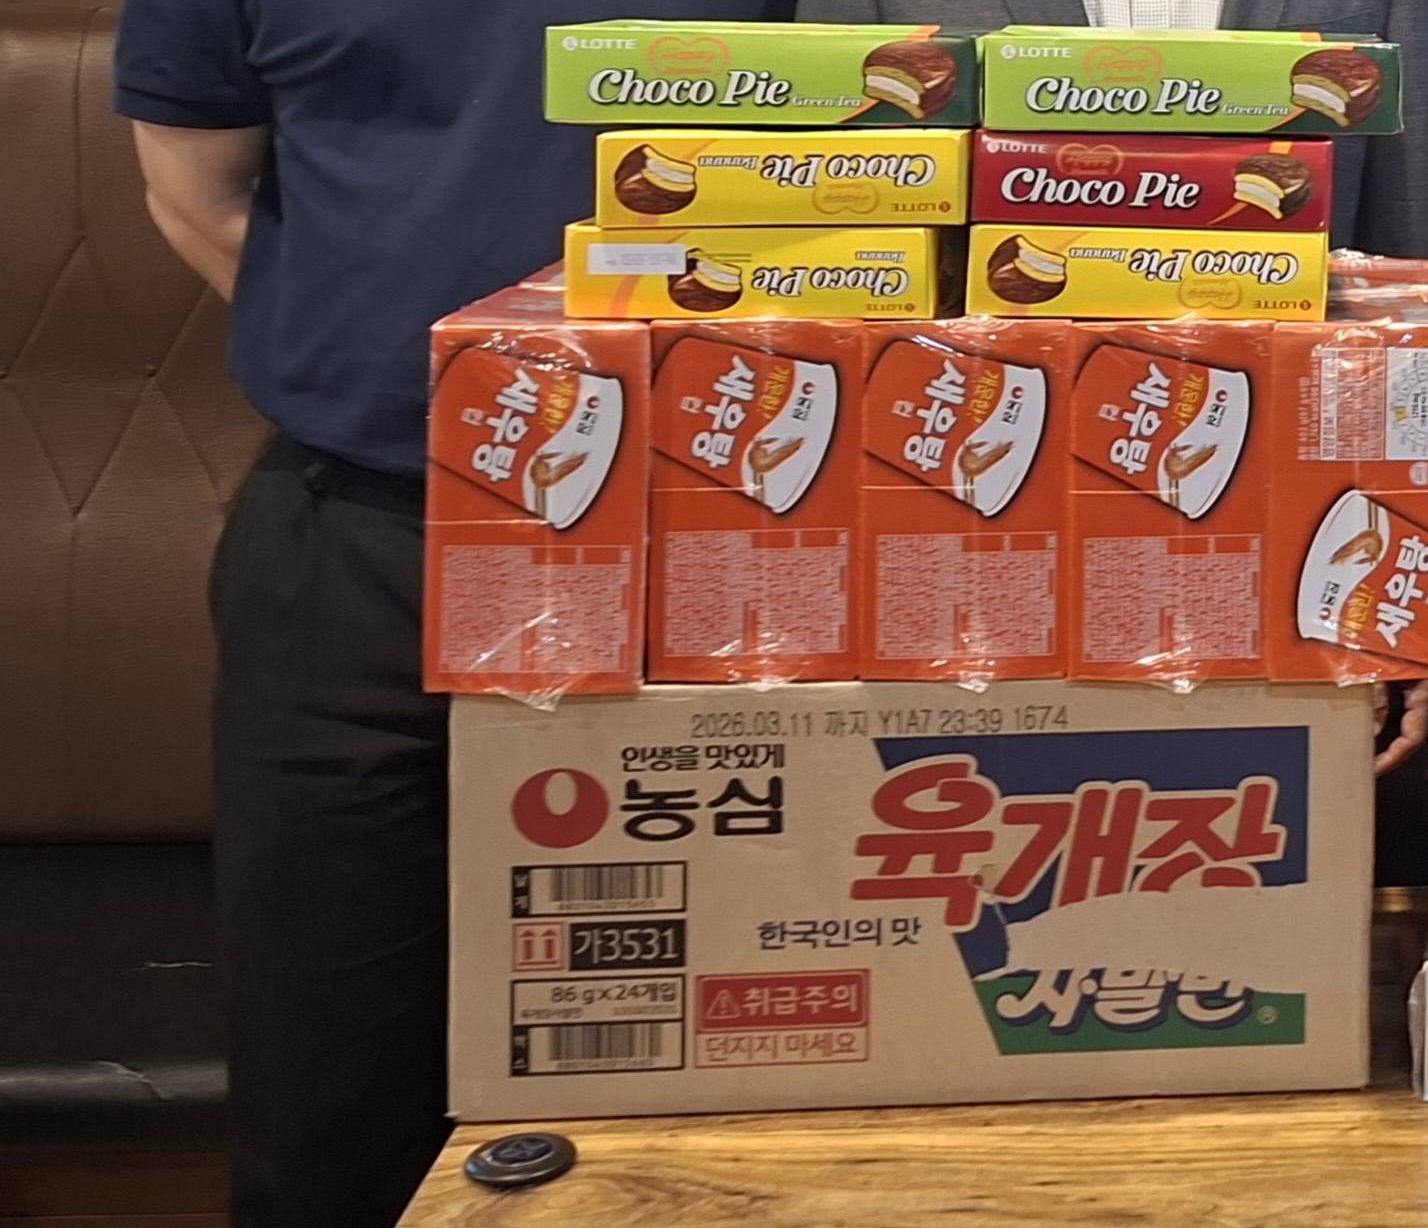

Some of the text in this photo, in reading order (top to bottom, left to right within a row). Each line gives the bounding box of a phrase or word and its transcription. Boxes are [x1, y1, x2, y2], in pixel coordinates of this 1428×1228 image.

[580, 38, 638, 50] LOTTE
[1019, 47, 1072, 58] LOTTE
[587, 68, 714, 106] Choco
[719, 69, 790, 106] Pie
[1026, 77, 1147, 113] Choco
[1152, 78, 1221, 114] Pie
[1222, 104, 1261, 115] Green
[1001, 143, 1048, 154] LOTTE
[698, 153, 937, 187] Choco Pie Banana
[1000, 167, 1200, 208] Choco Pie
[890, 202, 936, 213] LOTTE
[752, 266, 909, 296] Choco Pie
[1070, 248, 1299, 285] Choco Pie Banana
[865, 303, 905, 313] LOTTE
[1252, 300, 1297, 310] LOTTE
[472, 367, 540, 482] 새우탕
[691, 354, 757, 468] 새우탕
[903, 359, 967, 472] 새우탕
[1109, 362, 1173, 475] 새우탕
[691, 705, 1069, 739] 2026.03.11 까지 Y1A7 23:39 1674
[620, 743, 785, 772] 인생을 맛있게
[619, 775, 785, 842] 농심
[849, 755, 1287, 931] 육개장
[574, 927, 680, 964] 가3531
[757, 916, 921, 951] 한국인의 맛
[551, 986, 578, 1003] 86
[742, 983, 859, 1016] 취급주의
[705, 1031, 859, 1062] 던지지 마세요
